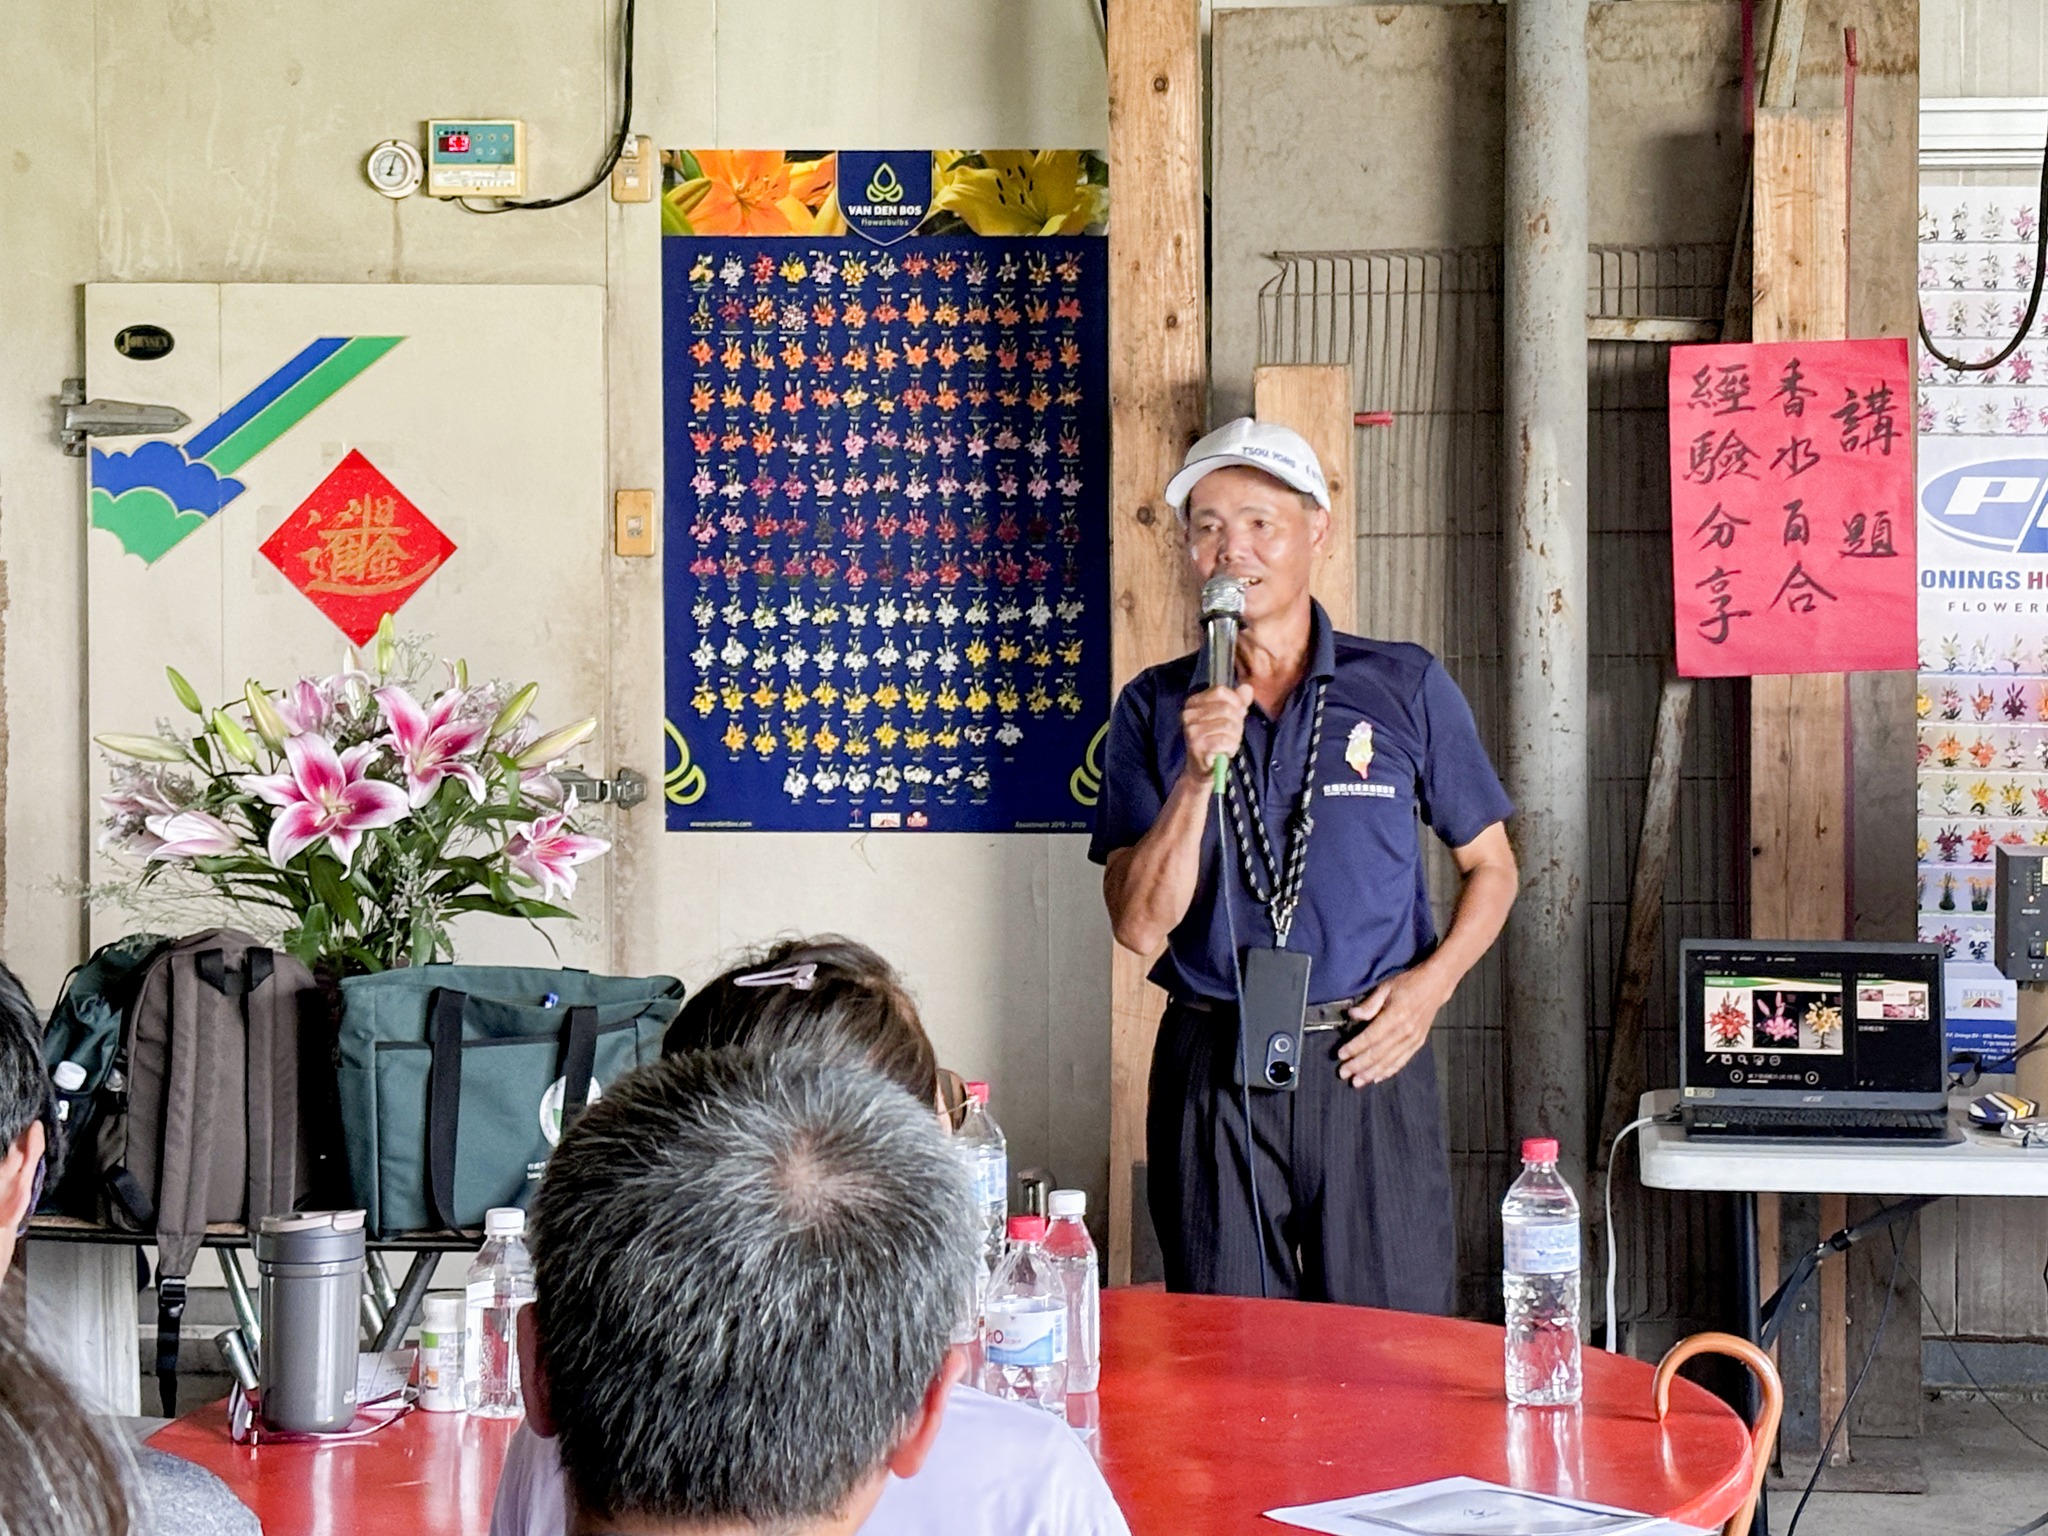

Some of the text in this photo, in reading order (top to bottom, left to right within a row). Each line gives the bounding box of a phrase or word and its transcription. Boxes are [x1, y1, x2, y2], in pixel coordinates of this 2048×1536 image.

[848, 205, 922, 216] VAN DEN BOS
[861, 218, 909, 226] flowerbulbs
[1242, 446, 1269, 457] TSOU
[1831, 380, 1902, 559] 講題
[1768, 357, 1838, 614] 香水百合
[1683, 363, 1761, 644] 經驗分享
[1921, 569, 2048, 590] ONINGS H
[1948, 602, 2048, 613] FLOWER
